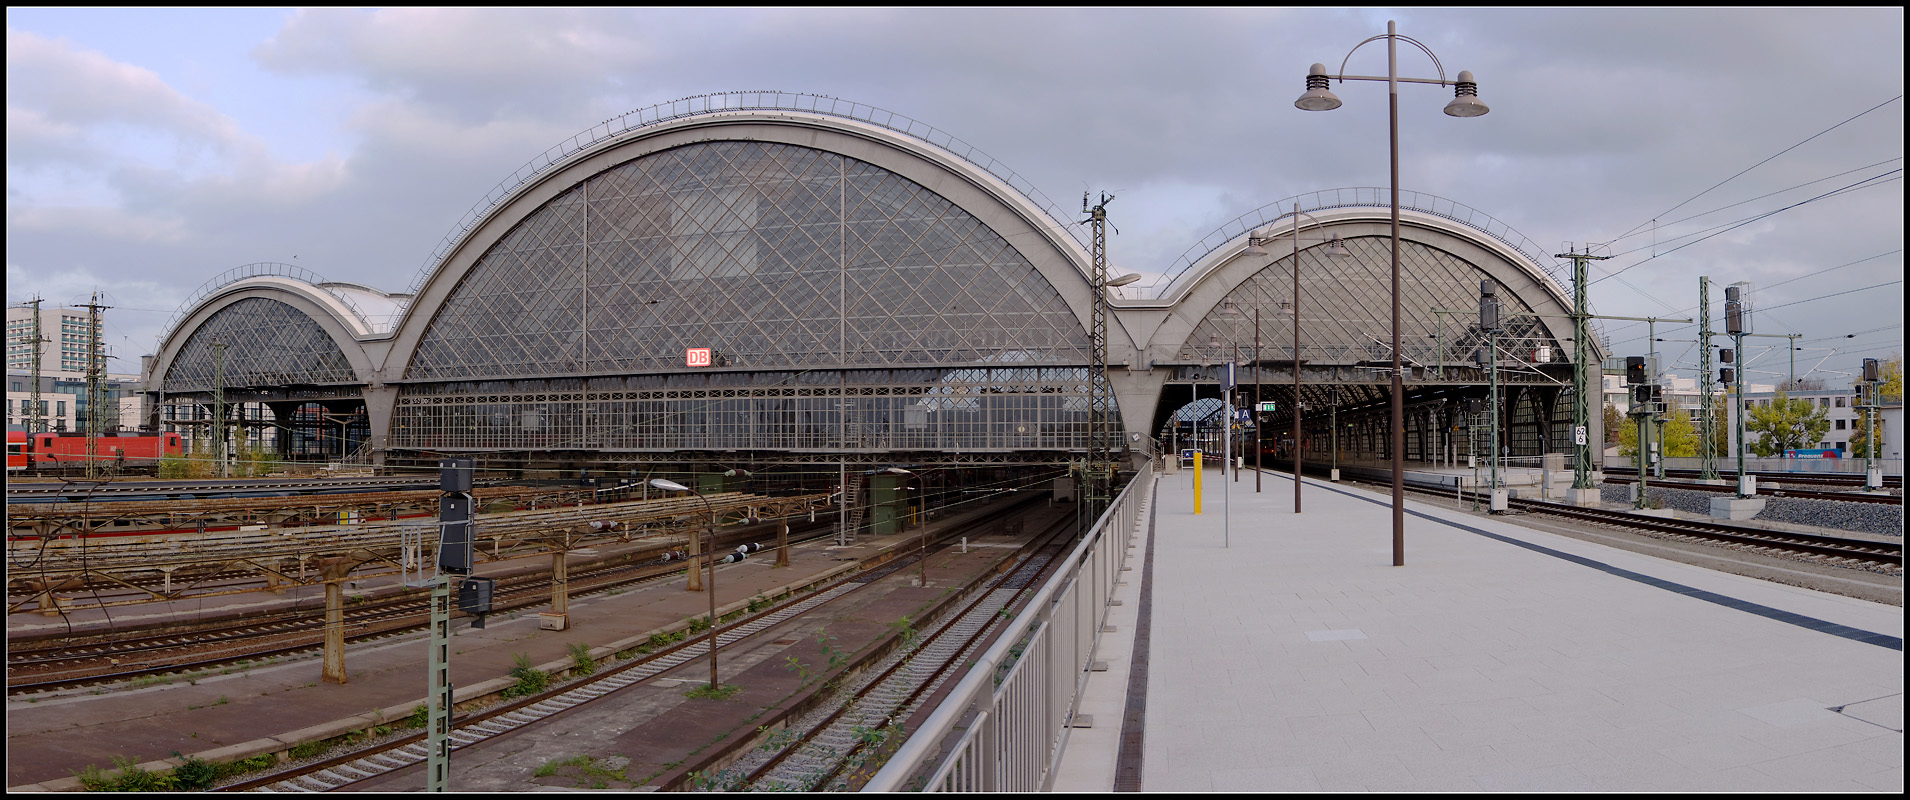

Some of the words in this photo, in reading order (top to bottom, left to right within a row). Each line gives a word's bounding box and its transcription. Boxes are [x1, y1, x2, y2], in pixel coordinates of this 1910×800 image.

[690, 351, 708, 363] DB
[1242, 409, 1250, 419] A
[1576, 427, 1585, 435] 62
